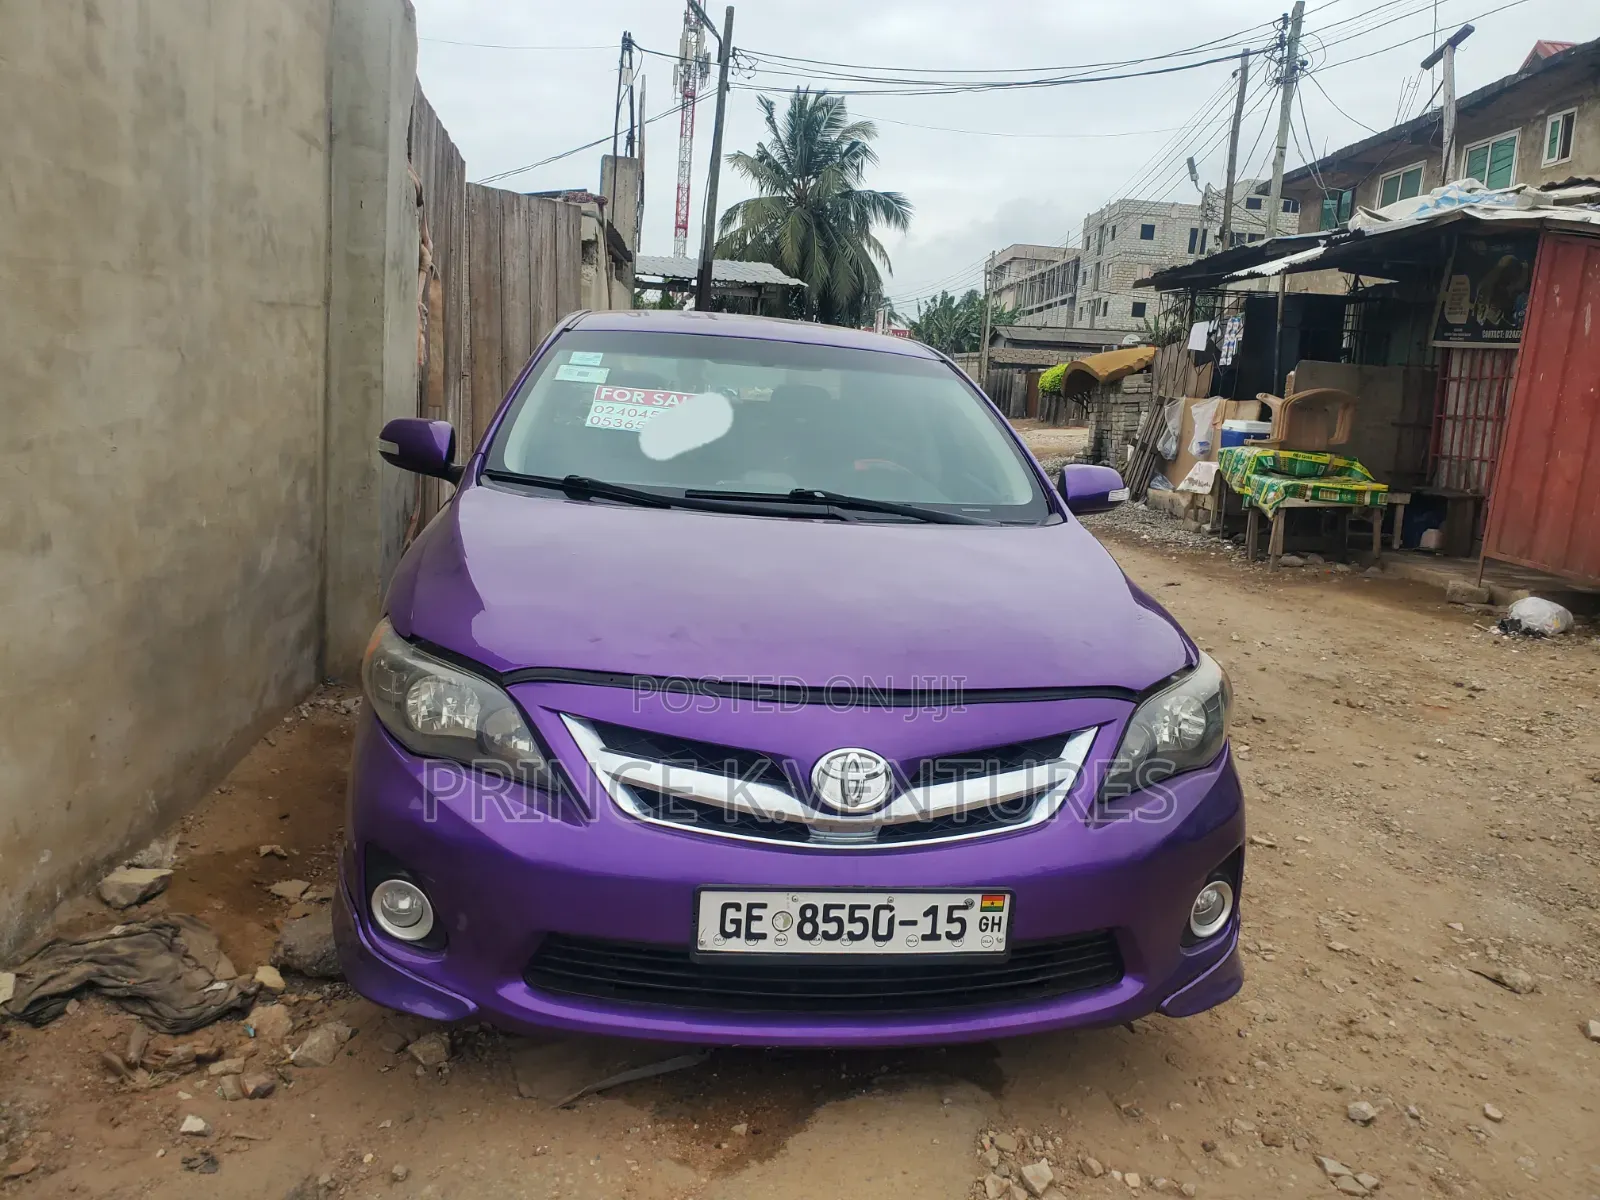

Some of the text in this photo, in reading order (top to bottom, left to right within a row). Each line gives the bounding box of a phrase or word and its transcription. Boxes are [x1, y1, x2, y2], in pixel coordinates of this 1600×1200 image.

[600, 387, 645, 404] FOR
[719, 902, 967, 942] GE 8550-15
[978, 915, 1003, 933] GH
